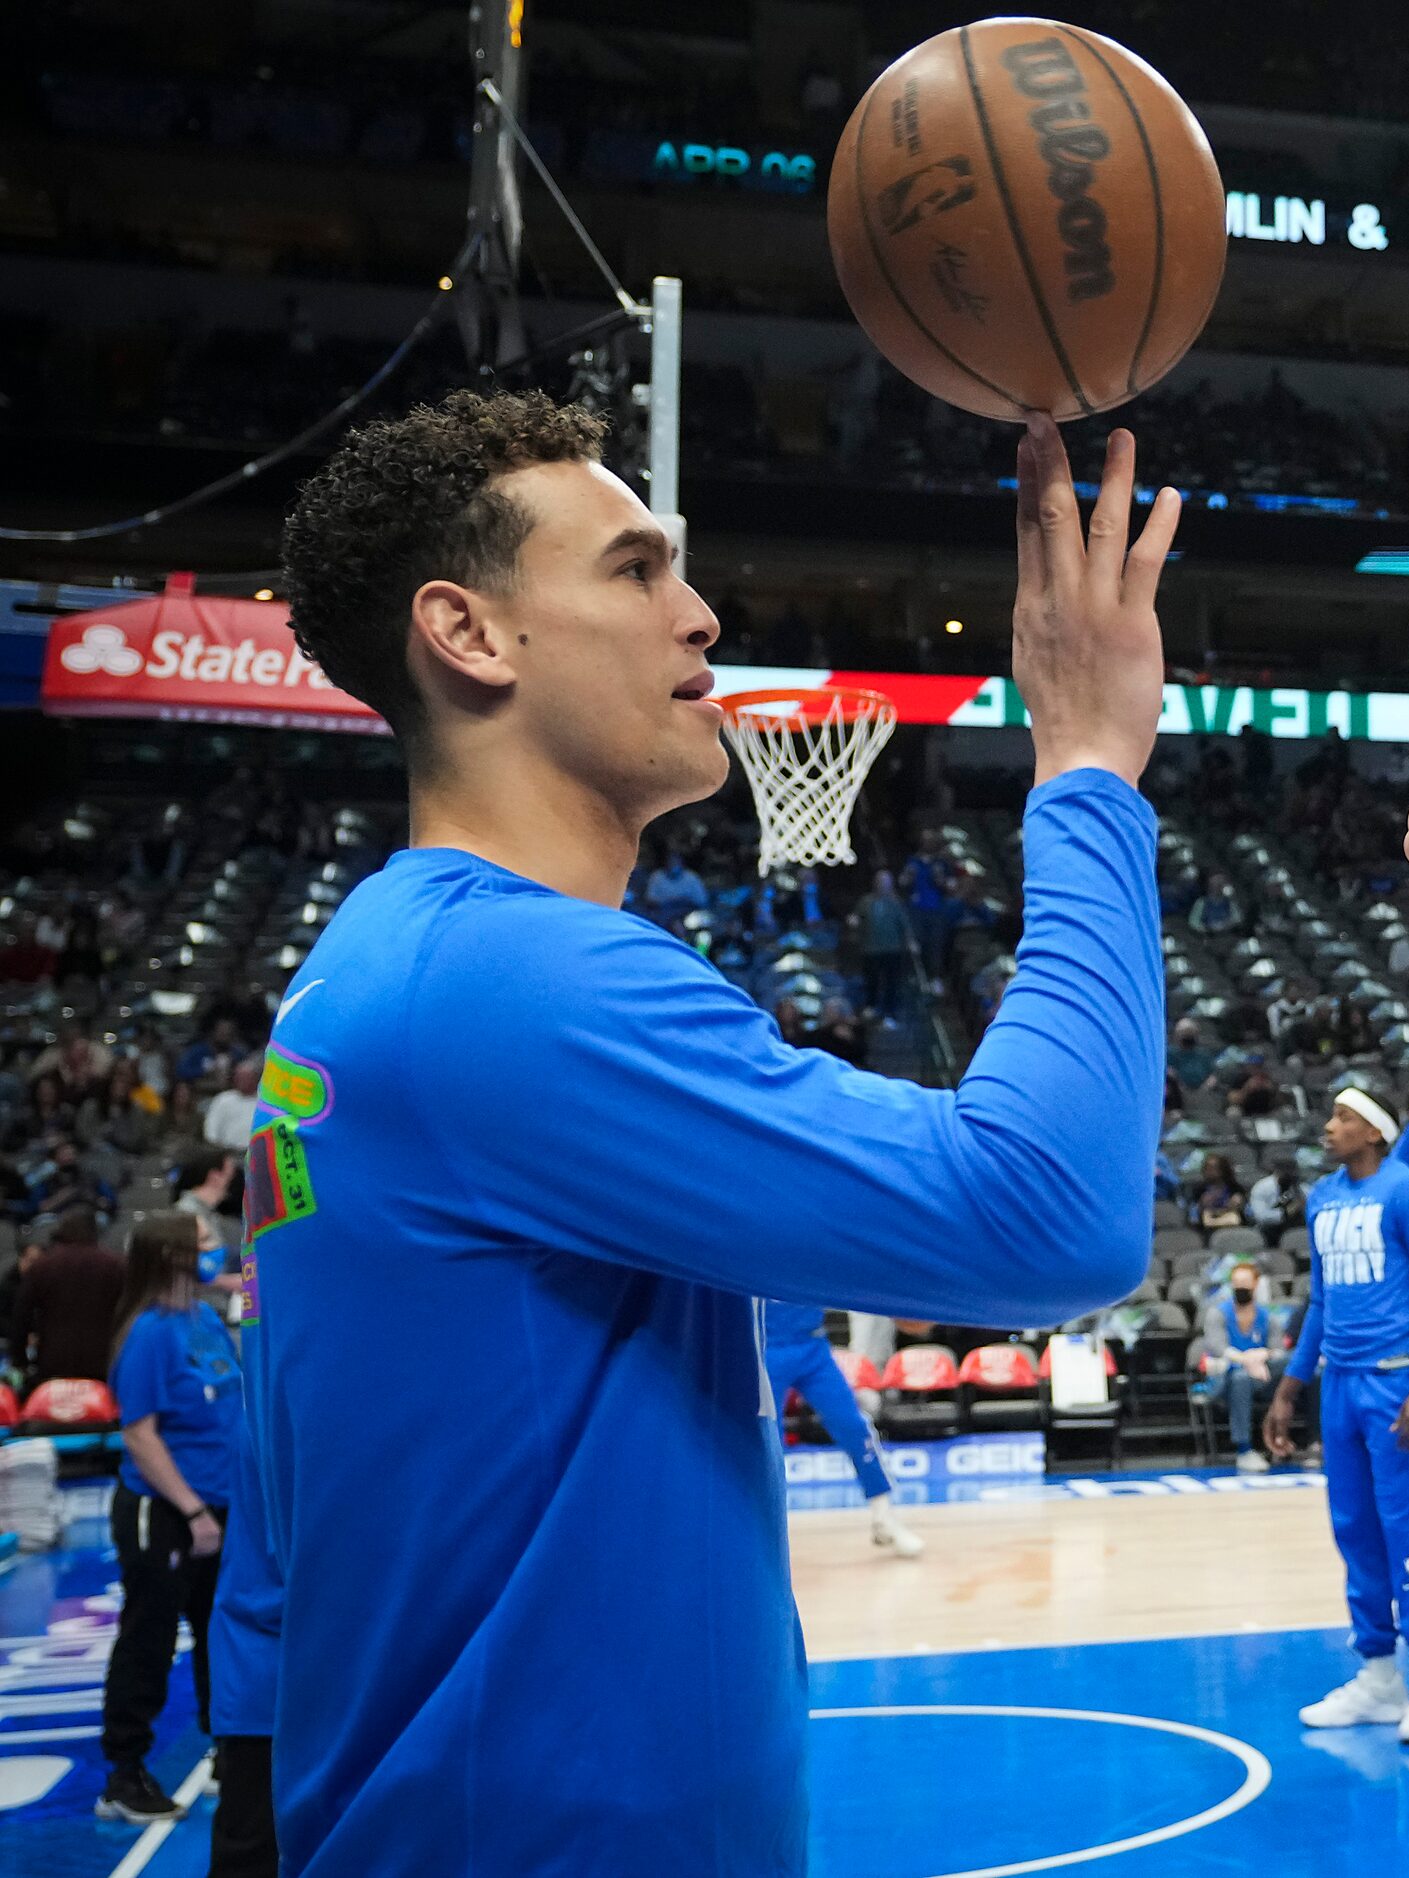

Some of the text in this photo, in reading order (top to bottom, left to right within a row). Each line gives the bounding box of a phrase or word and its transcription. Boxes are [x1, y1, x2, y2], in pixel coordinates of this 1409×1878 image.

[1002, 36, 1118, 304] Wilson
[1347, 202, 1390, 252] &
[145, 630, 285, 685] State
